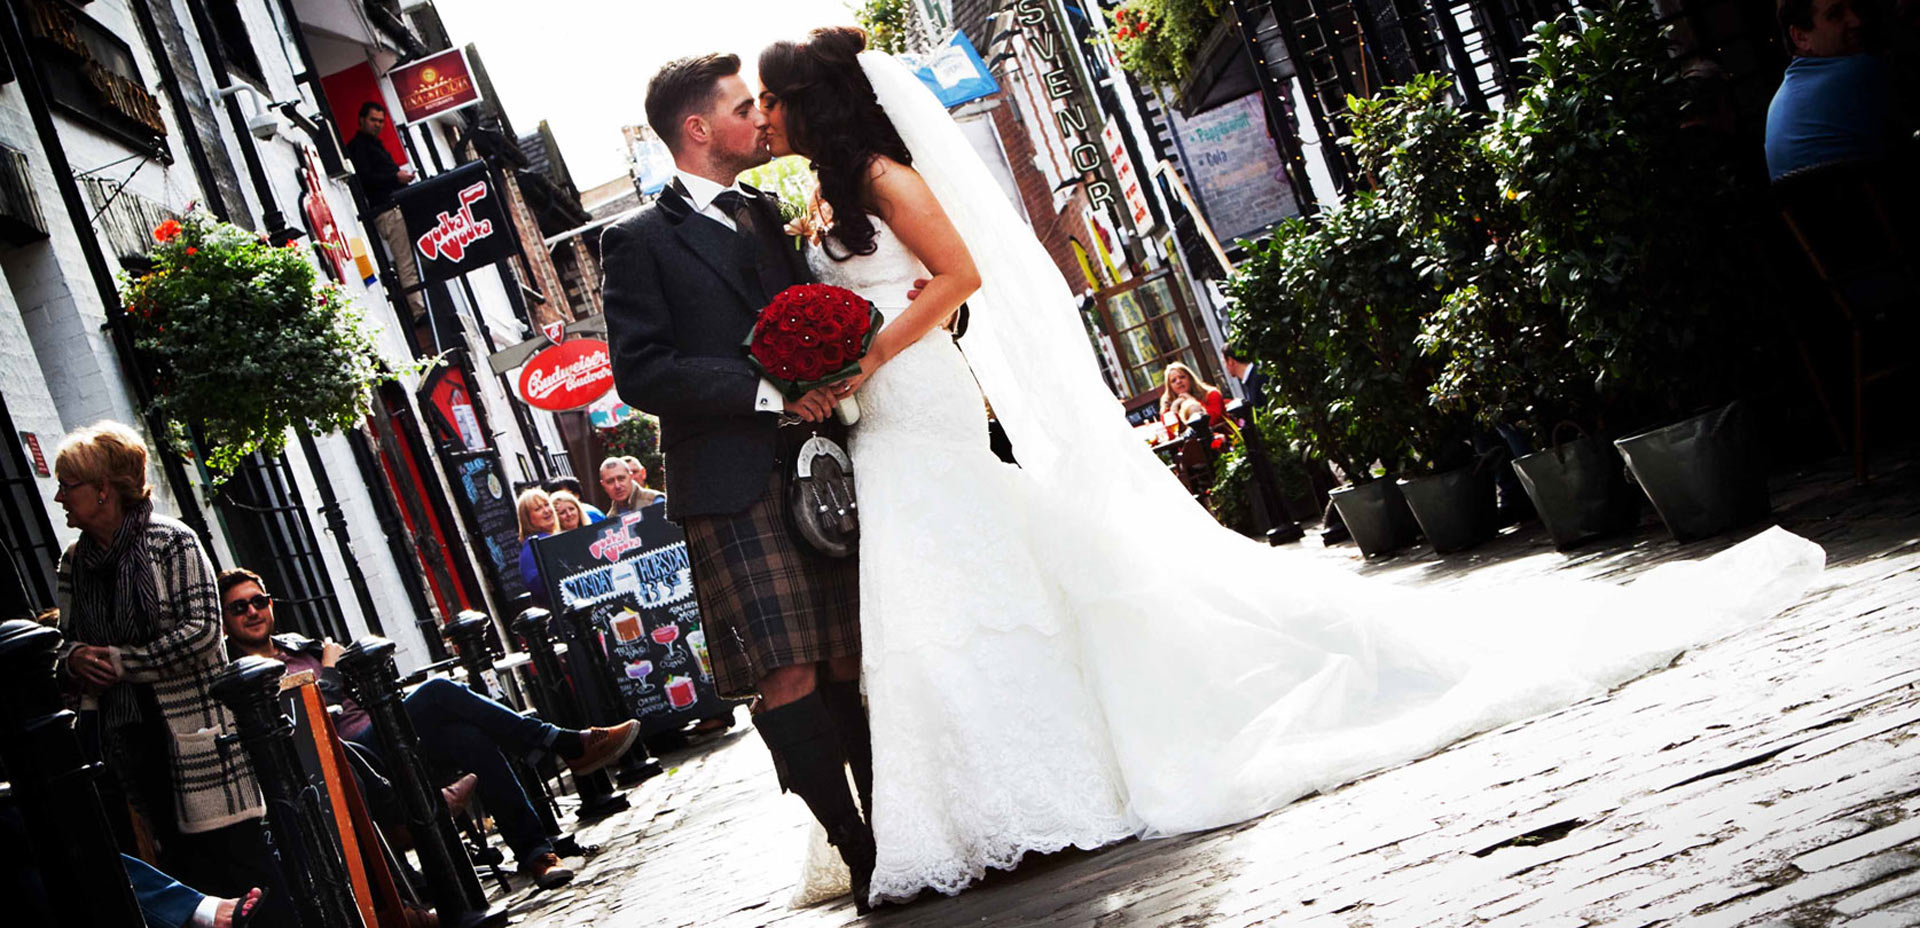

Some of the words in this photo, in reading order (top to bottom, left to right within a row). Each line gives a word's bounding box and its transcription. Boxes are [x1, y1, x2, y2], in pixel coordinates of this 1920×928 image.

[527, 350, 610, 400] Budweiser
[564, 567, 615, 600] SUNDAY
[631, 546, 690, 582] THURSDAY
